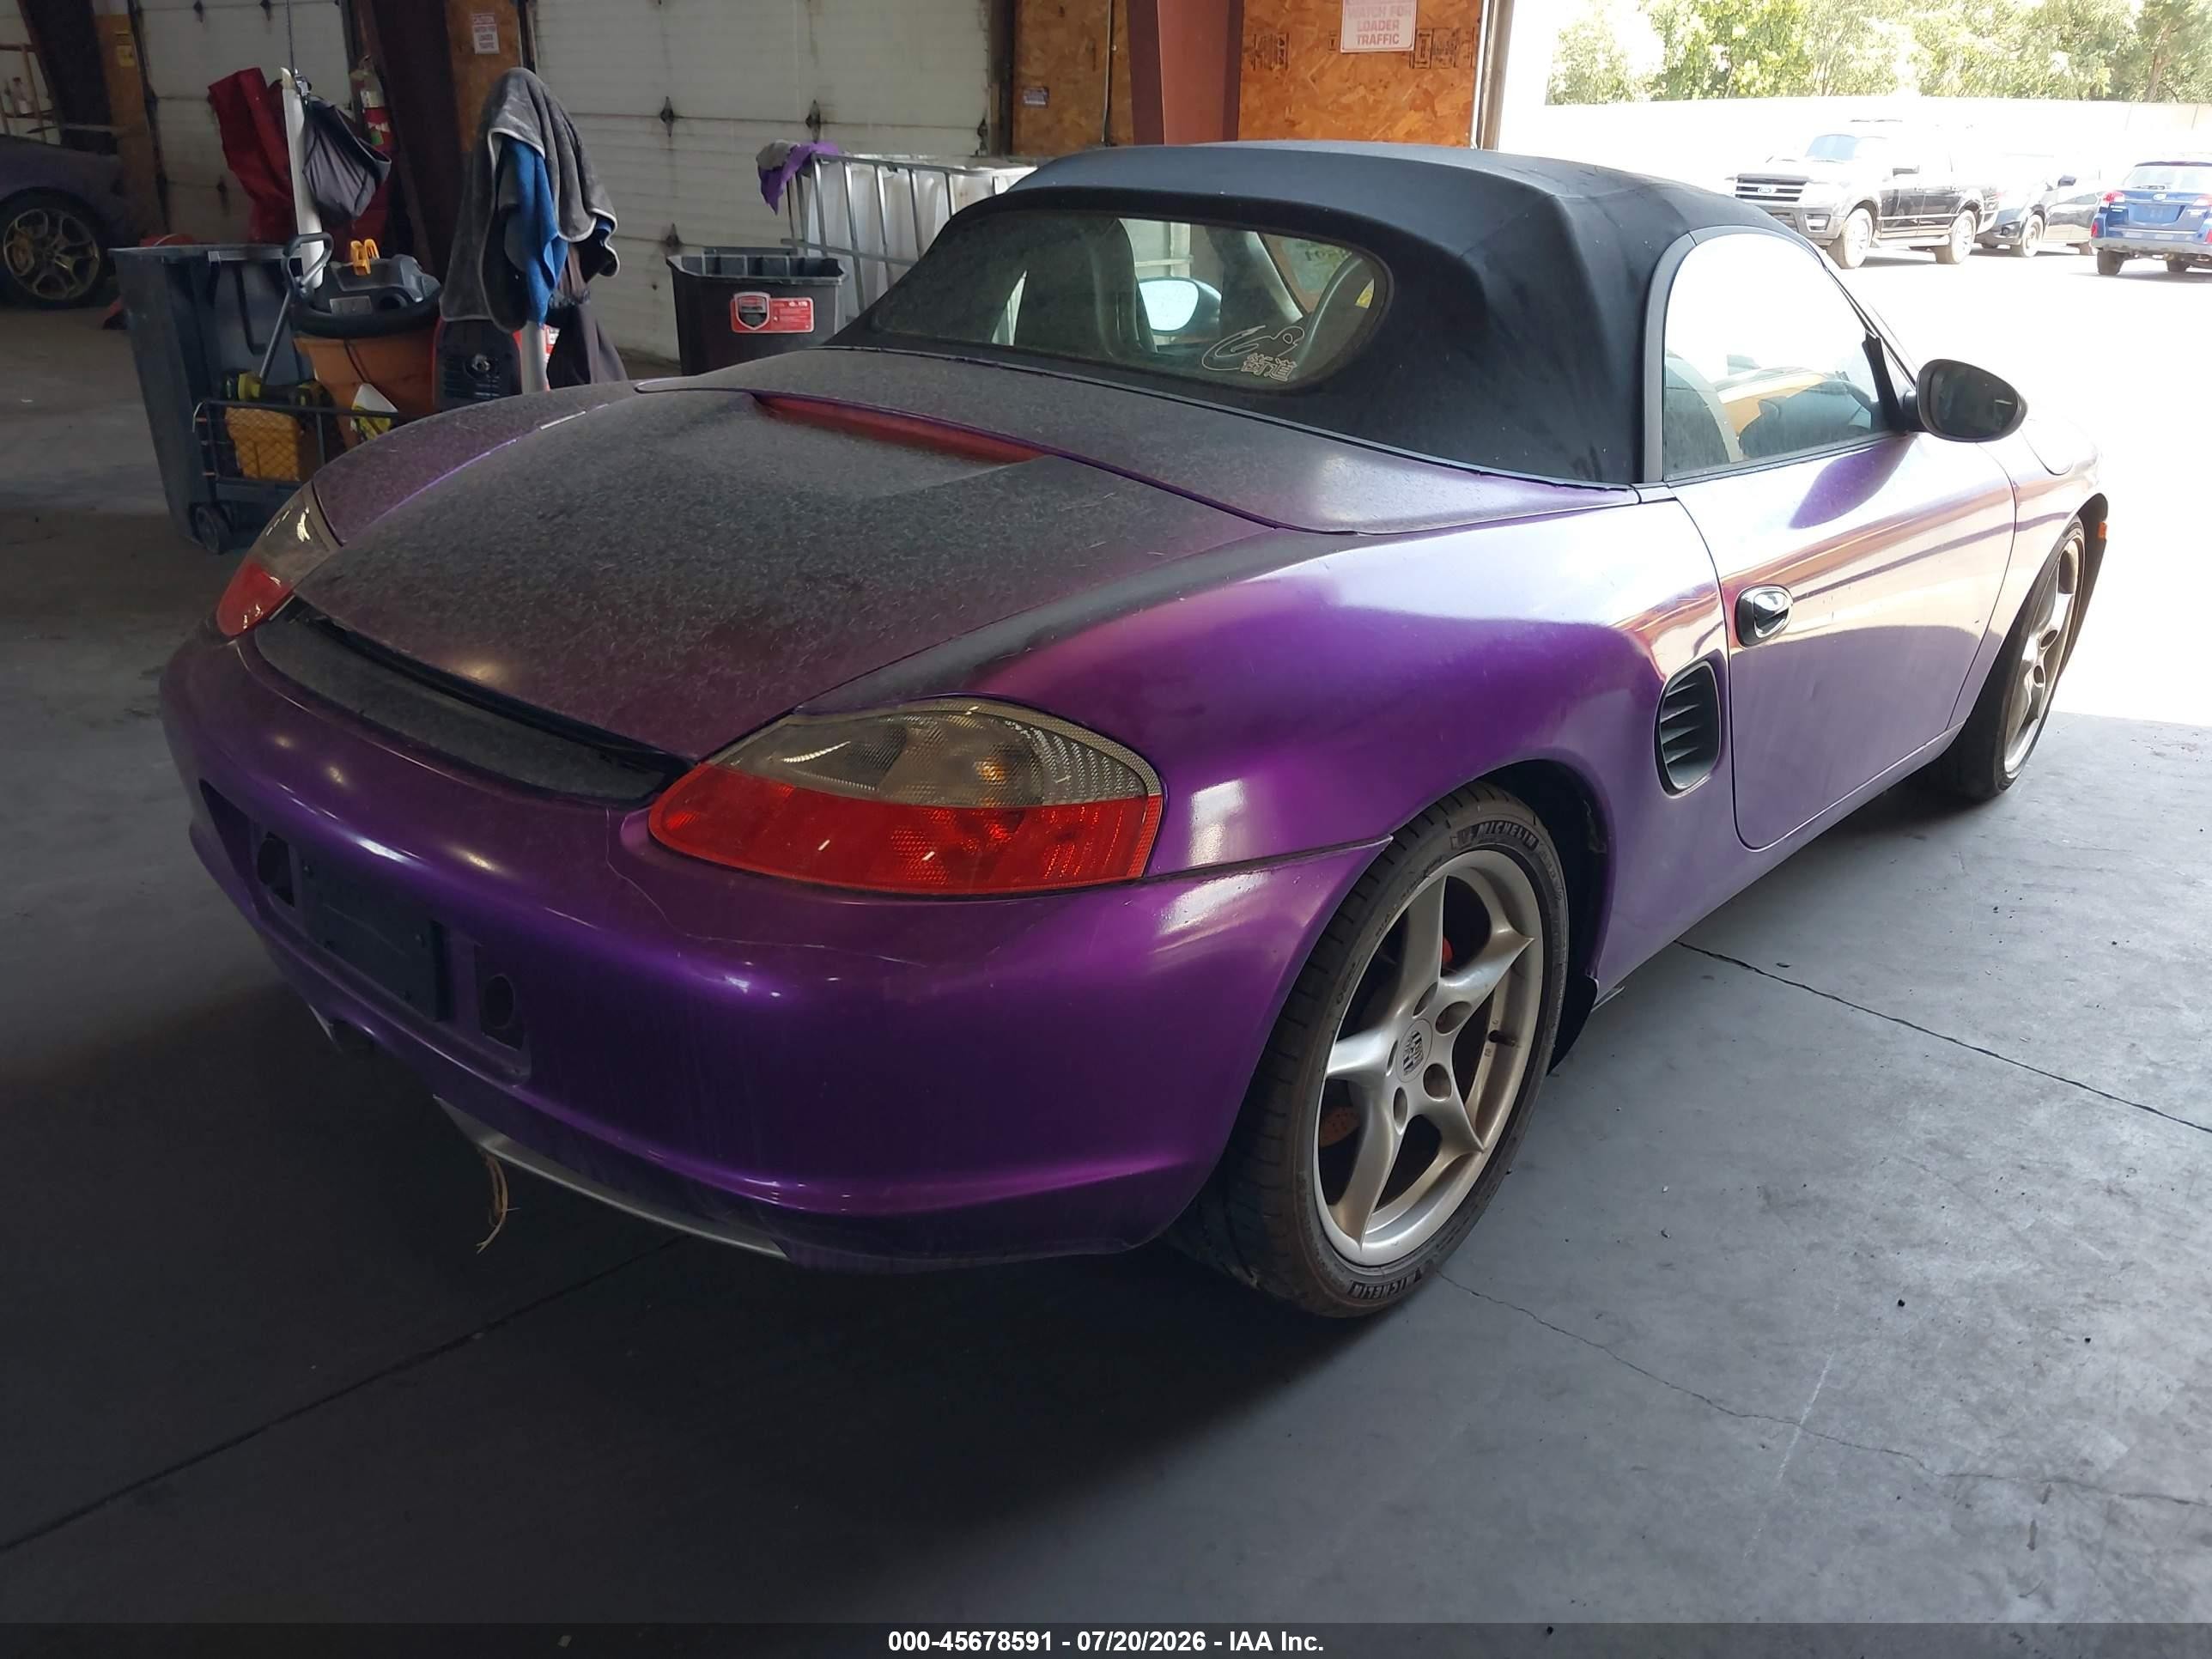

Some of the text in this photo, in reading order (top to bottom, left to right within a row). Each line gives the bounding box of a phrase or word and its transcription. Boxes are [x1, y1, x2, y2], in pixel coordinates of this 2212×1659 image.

[1357, 20, 1400, 32] LOADER
[1357, 33, 1400, 46] TRAFFIC
[1477, 821, 1537, 848] MICHELIN
